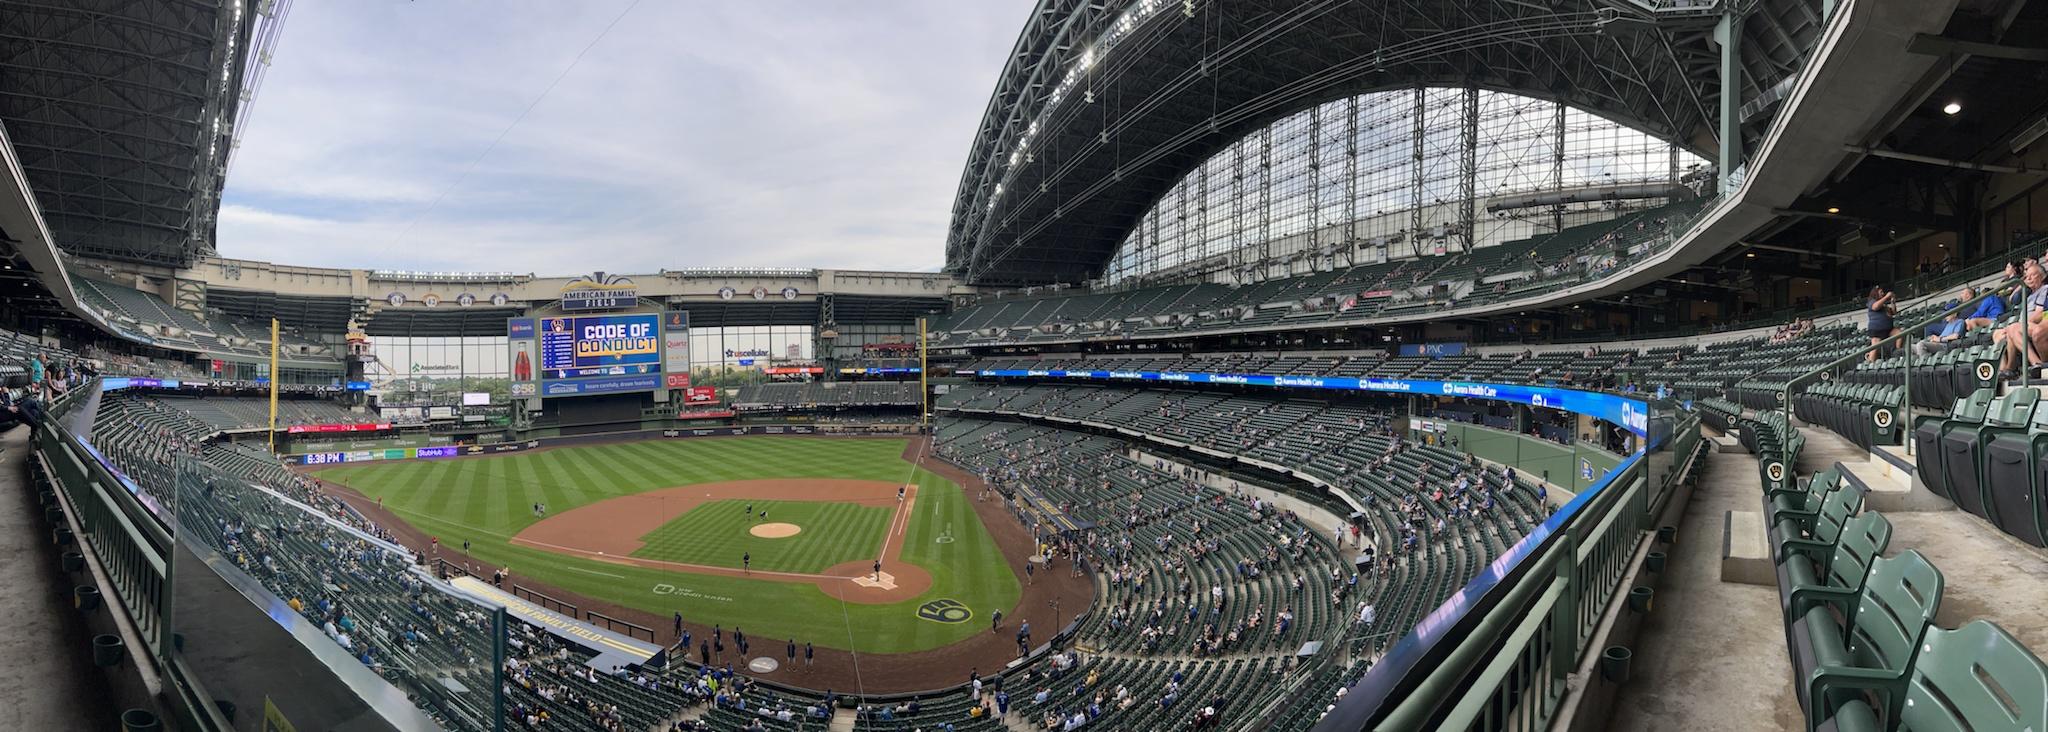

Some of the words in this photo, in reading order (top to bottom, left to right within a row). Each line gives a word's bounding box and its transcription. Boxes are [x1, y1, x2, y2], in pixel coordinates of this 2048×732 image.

[586, 299, 616, 307] FIELD
[584, 324, 626, 339] CODE
[630, 323, 650, 337] OF
[579, 337, 654, 353] CONDUCT
[1427, 344, 1444, 354] PNC
[520, 383, 536, 392] 58
[307, 454, 326, 464] 6:38
[326, 453, 340, 463] PM
